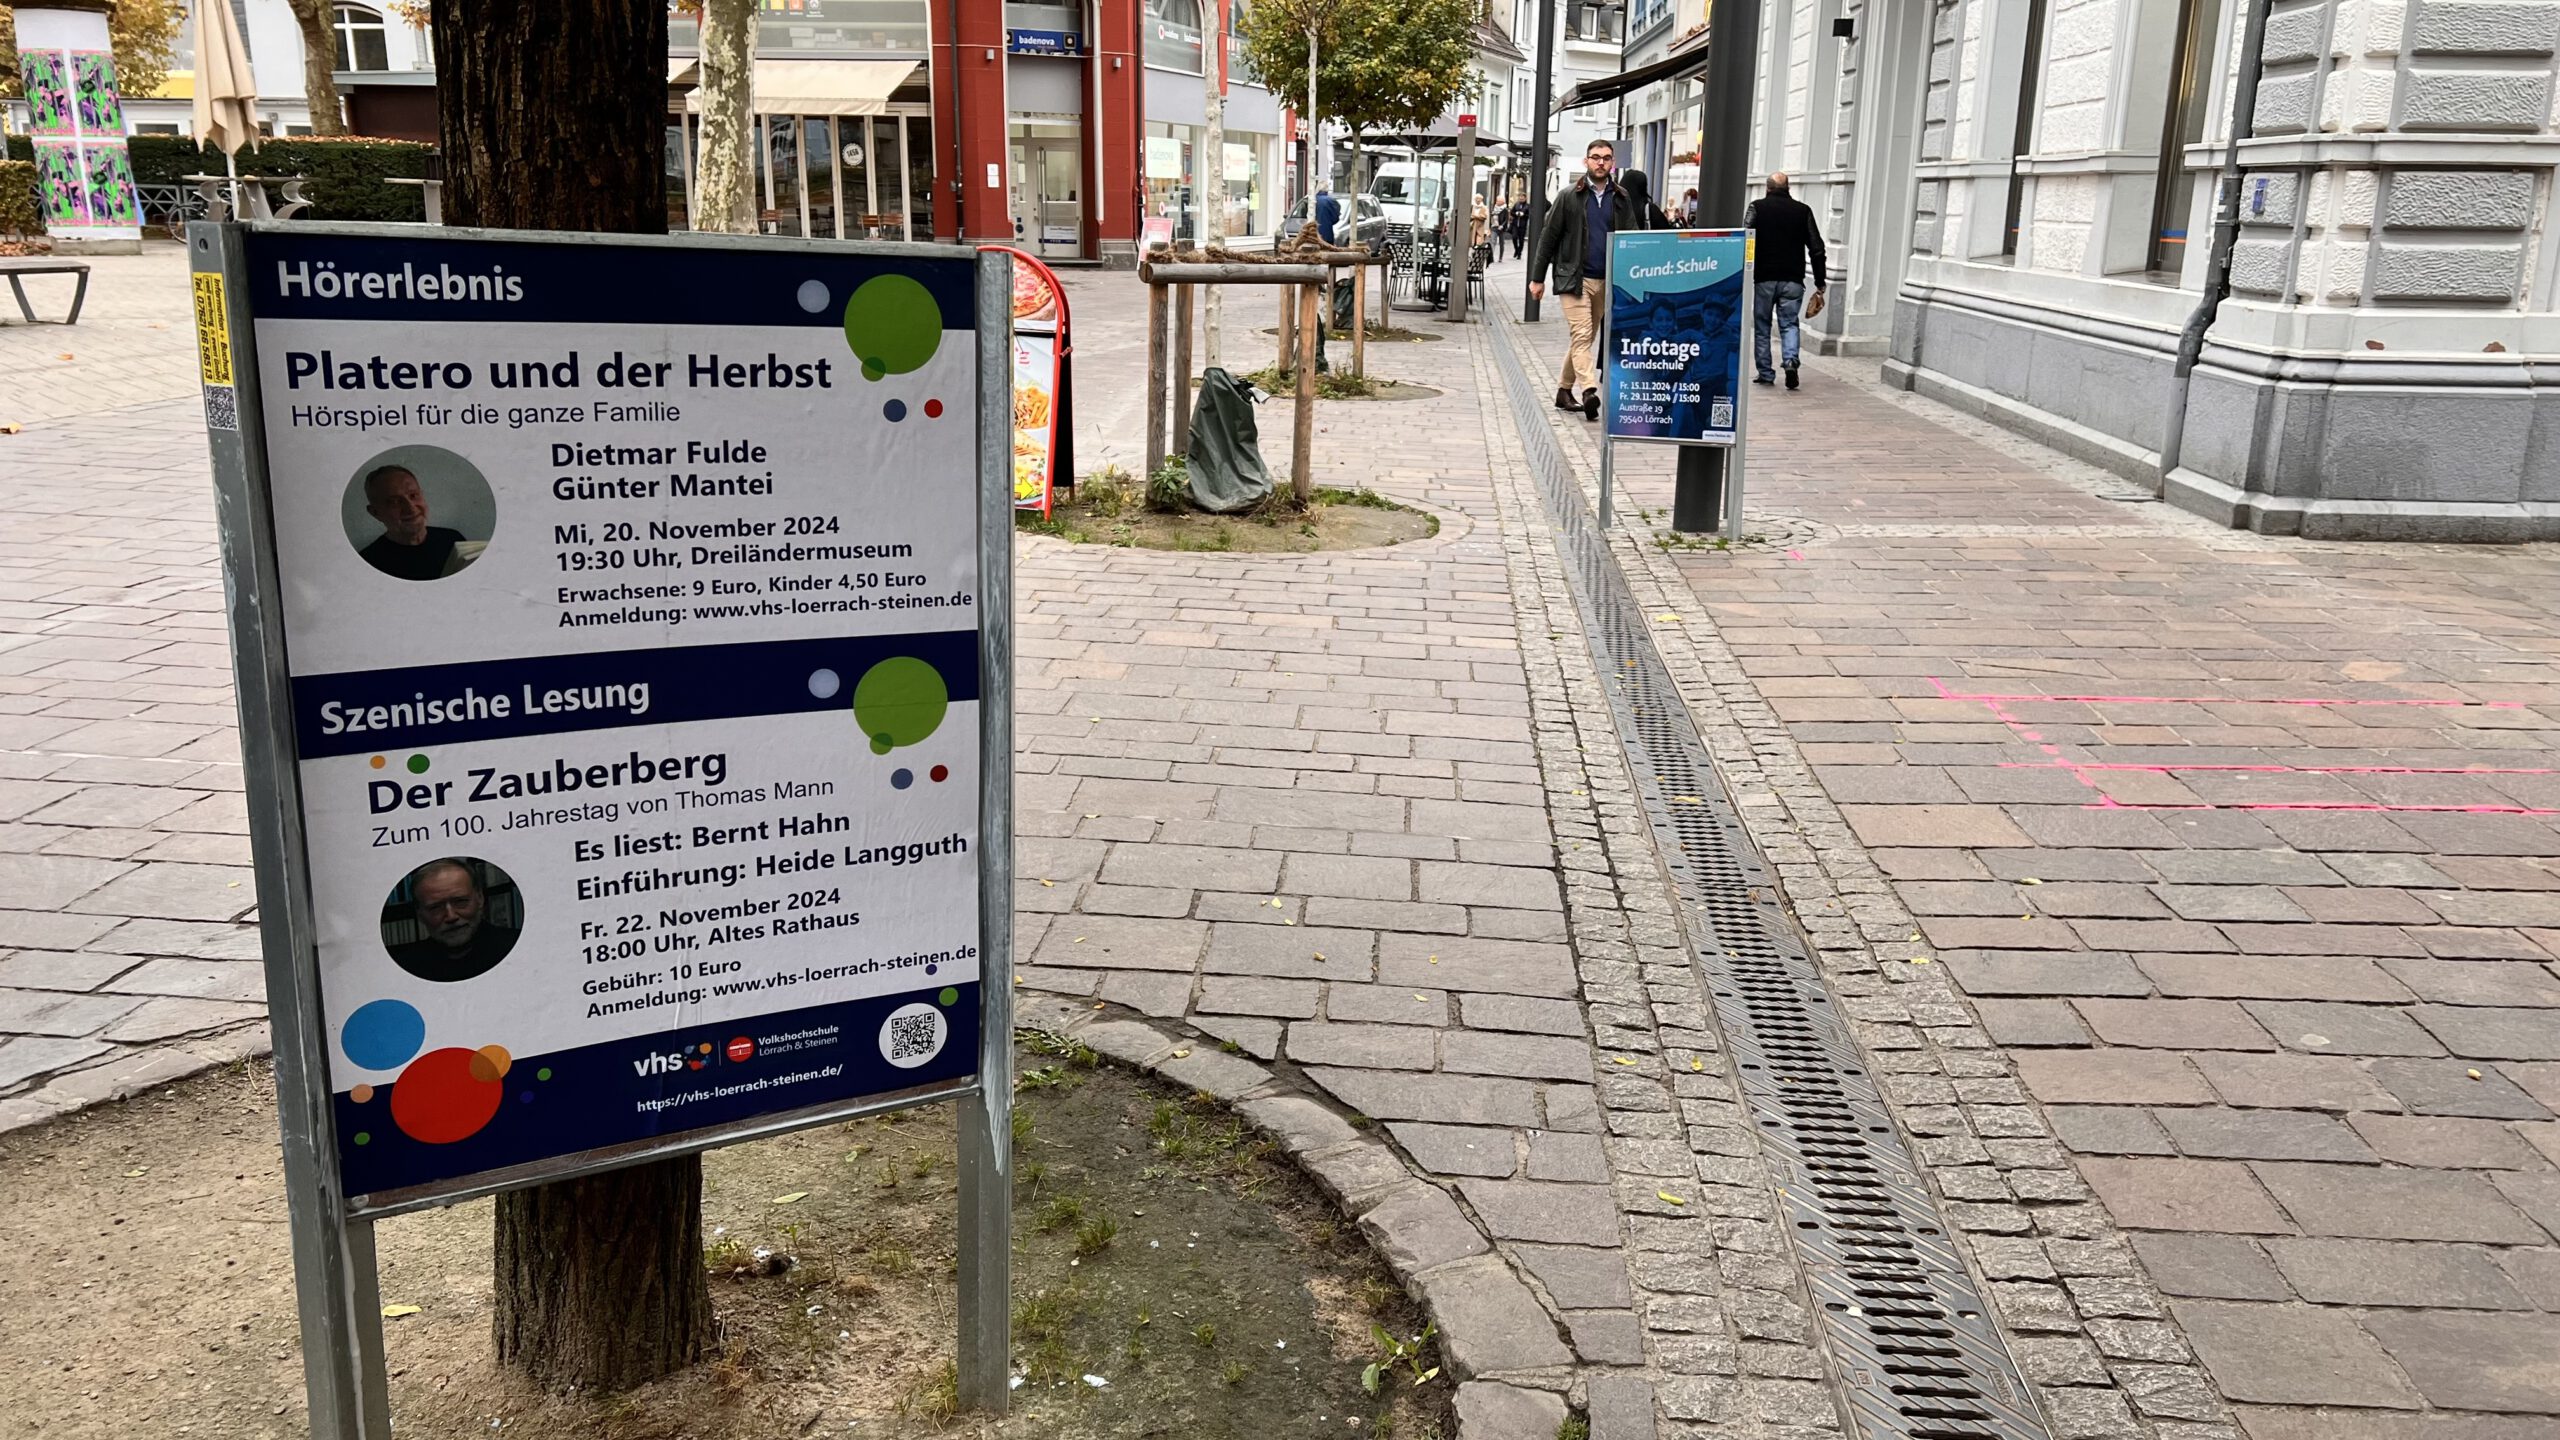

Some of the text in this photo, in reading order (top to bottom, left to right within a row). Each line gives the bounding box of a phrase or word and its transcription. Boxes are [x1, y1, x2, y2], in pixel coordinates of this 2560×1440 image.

[1019, 35, 1055, 46] badenova
[277, 261, 524, 303] Hörerlebnis
[1630, 256, 1718, 279] Grund: Schule
[194, 277, 203, 293] Tel.
[197, 296, 207, 328] 07621
[214, 278, 225, 331] Information
[220, 342, 230, 382] Buchung
[1621, 337, 1700, 361] Infotage
[286, 350, 831, 389] Platero und der Herbst
[1620, 358, 1684, 370] Grundschule
[1620, 381, 1629, 390] Fr.
[1631, 381, 1671, 391] 15.11.2024
[1679, 382, 1700, 392] 15:00
[1620, 392, 1629, 401] Fr.
[1630, 392, 1671, 401] 29.11.2024
[1679, 394, 1700, 403] 15:00
[292, 402, 680, 431] Hörspiel für die ganze Familie
[1619, 403, 1664, 414] Austraße 19
[1619, 414, 1673, 424] 79540 Lörrach
[552, 440, 766, 467] Dietmar Fulde
[553, 472, 772, 500] Günter Mantei
[555, 516, 839, 545] Mi, 20. November 2024
[557, 543, 912, 571] 19:30 Uhr, Dreiländermuseum
[558, 573, 926, 603] Erwachsene: 9 Euro, Kinder 4,50 Euro
[559, 591, 973, 627] Anmeldung: www.vhs-loerrach-steinen.de
[320, 680, 650, 734] Szenische Lesung
[368, 751, 727, 814] Der Zauberberg
[372, 782, 833, 847] Zum 100. Jahrestag von Thomas Mann
[575, 813, 849, 862] Es liest: Bernt Hahn
[578, 833, 966, 900] Einführung: Heide Langguth
[581, 888, 840, 940] Fr. 22. November 2024
[583, 913, 859, 965] 18:00 Uhr, Altes Rathaus
[583, 961, 741, 995] Gebühr: 10 Euro
[587, 946, 977, 1018] Anmeldung: www.vhs-loerrach-steinen.de
[758, 1025, 840, 1046] Volkshochschule
[759, 1036, 838, 1056] Lörrach & Steinen
[634, 1051, 683, 1077] vhs
[636, 1063, 844, 1112] https://vhs-loerrach-steinen.de/
